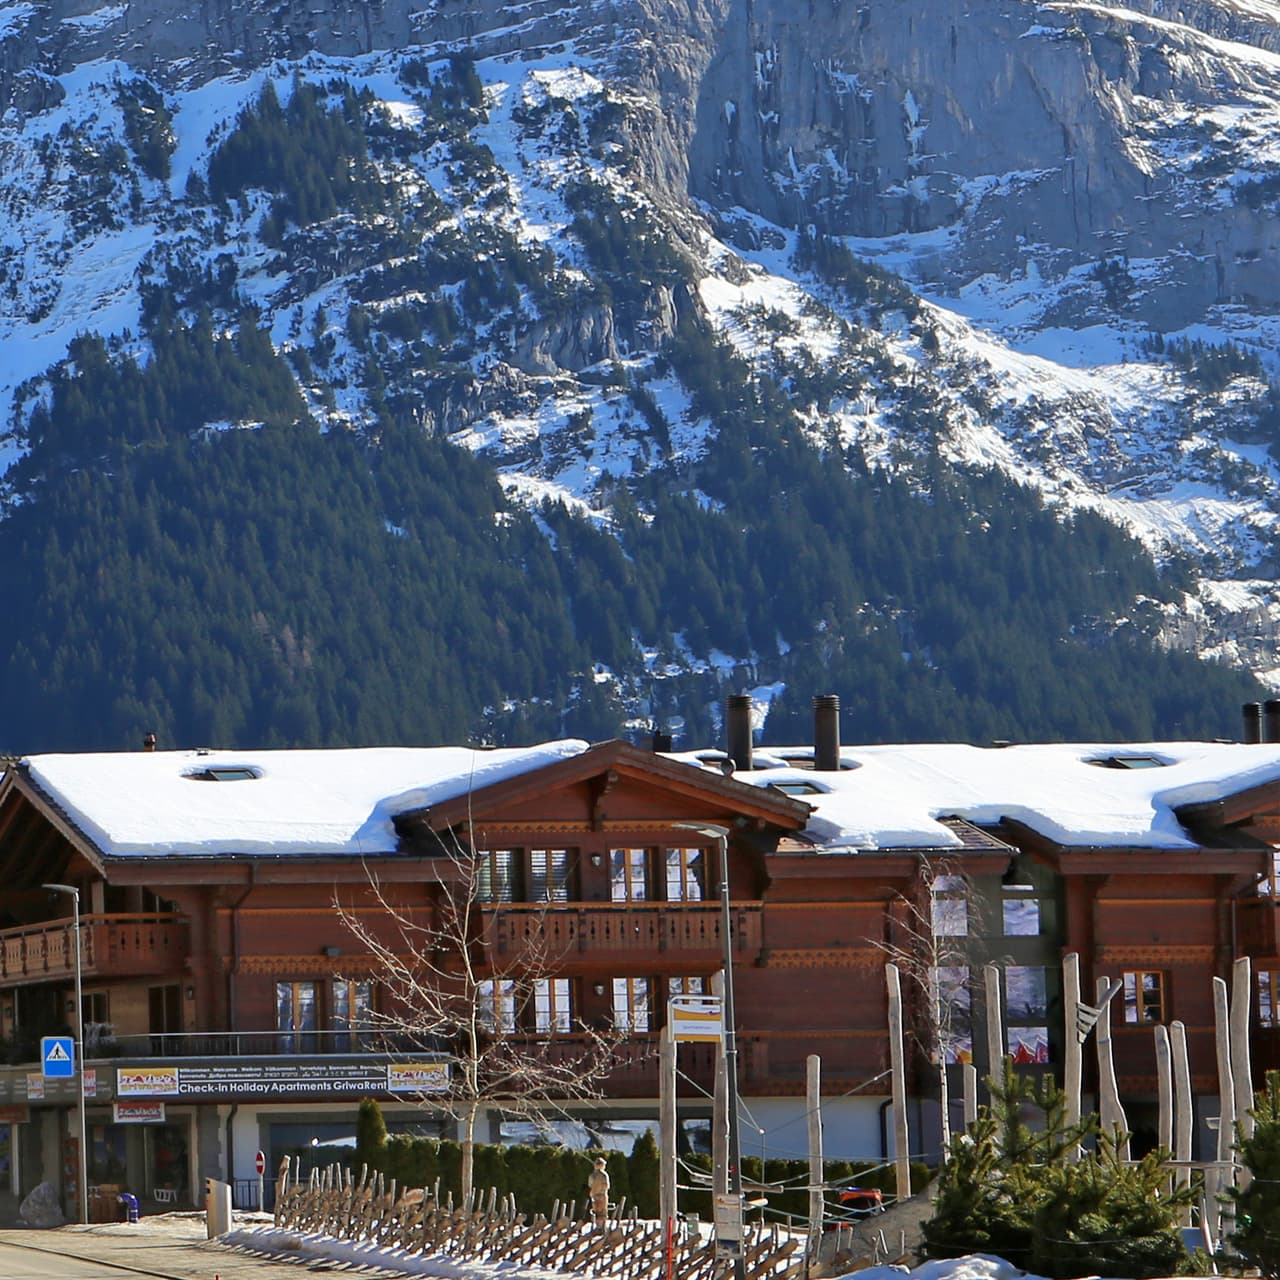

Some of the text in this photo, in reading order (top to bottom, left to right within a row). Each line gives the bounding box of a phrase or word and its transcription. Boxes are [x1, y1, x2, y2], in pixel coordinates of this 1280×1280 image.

[180, 1082, 228, 1093] Check-in
[230, 1082, 270, 1095] Holiday
[271, 1081, 332, 1093] Apartments
[333, 1079, 387, 1091] GriwaRent
